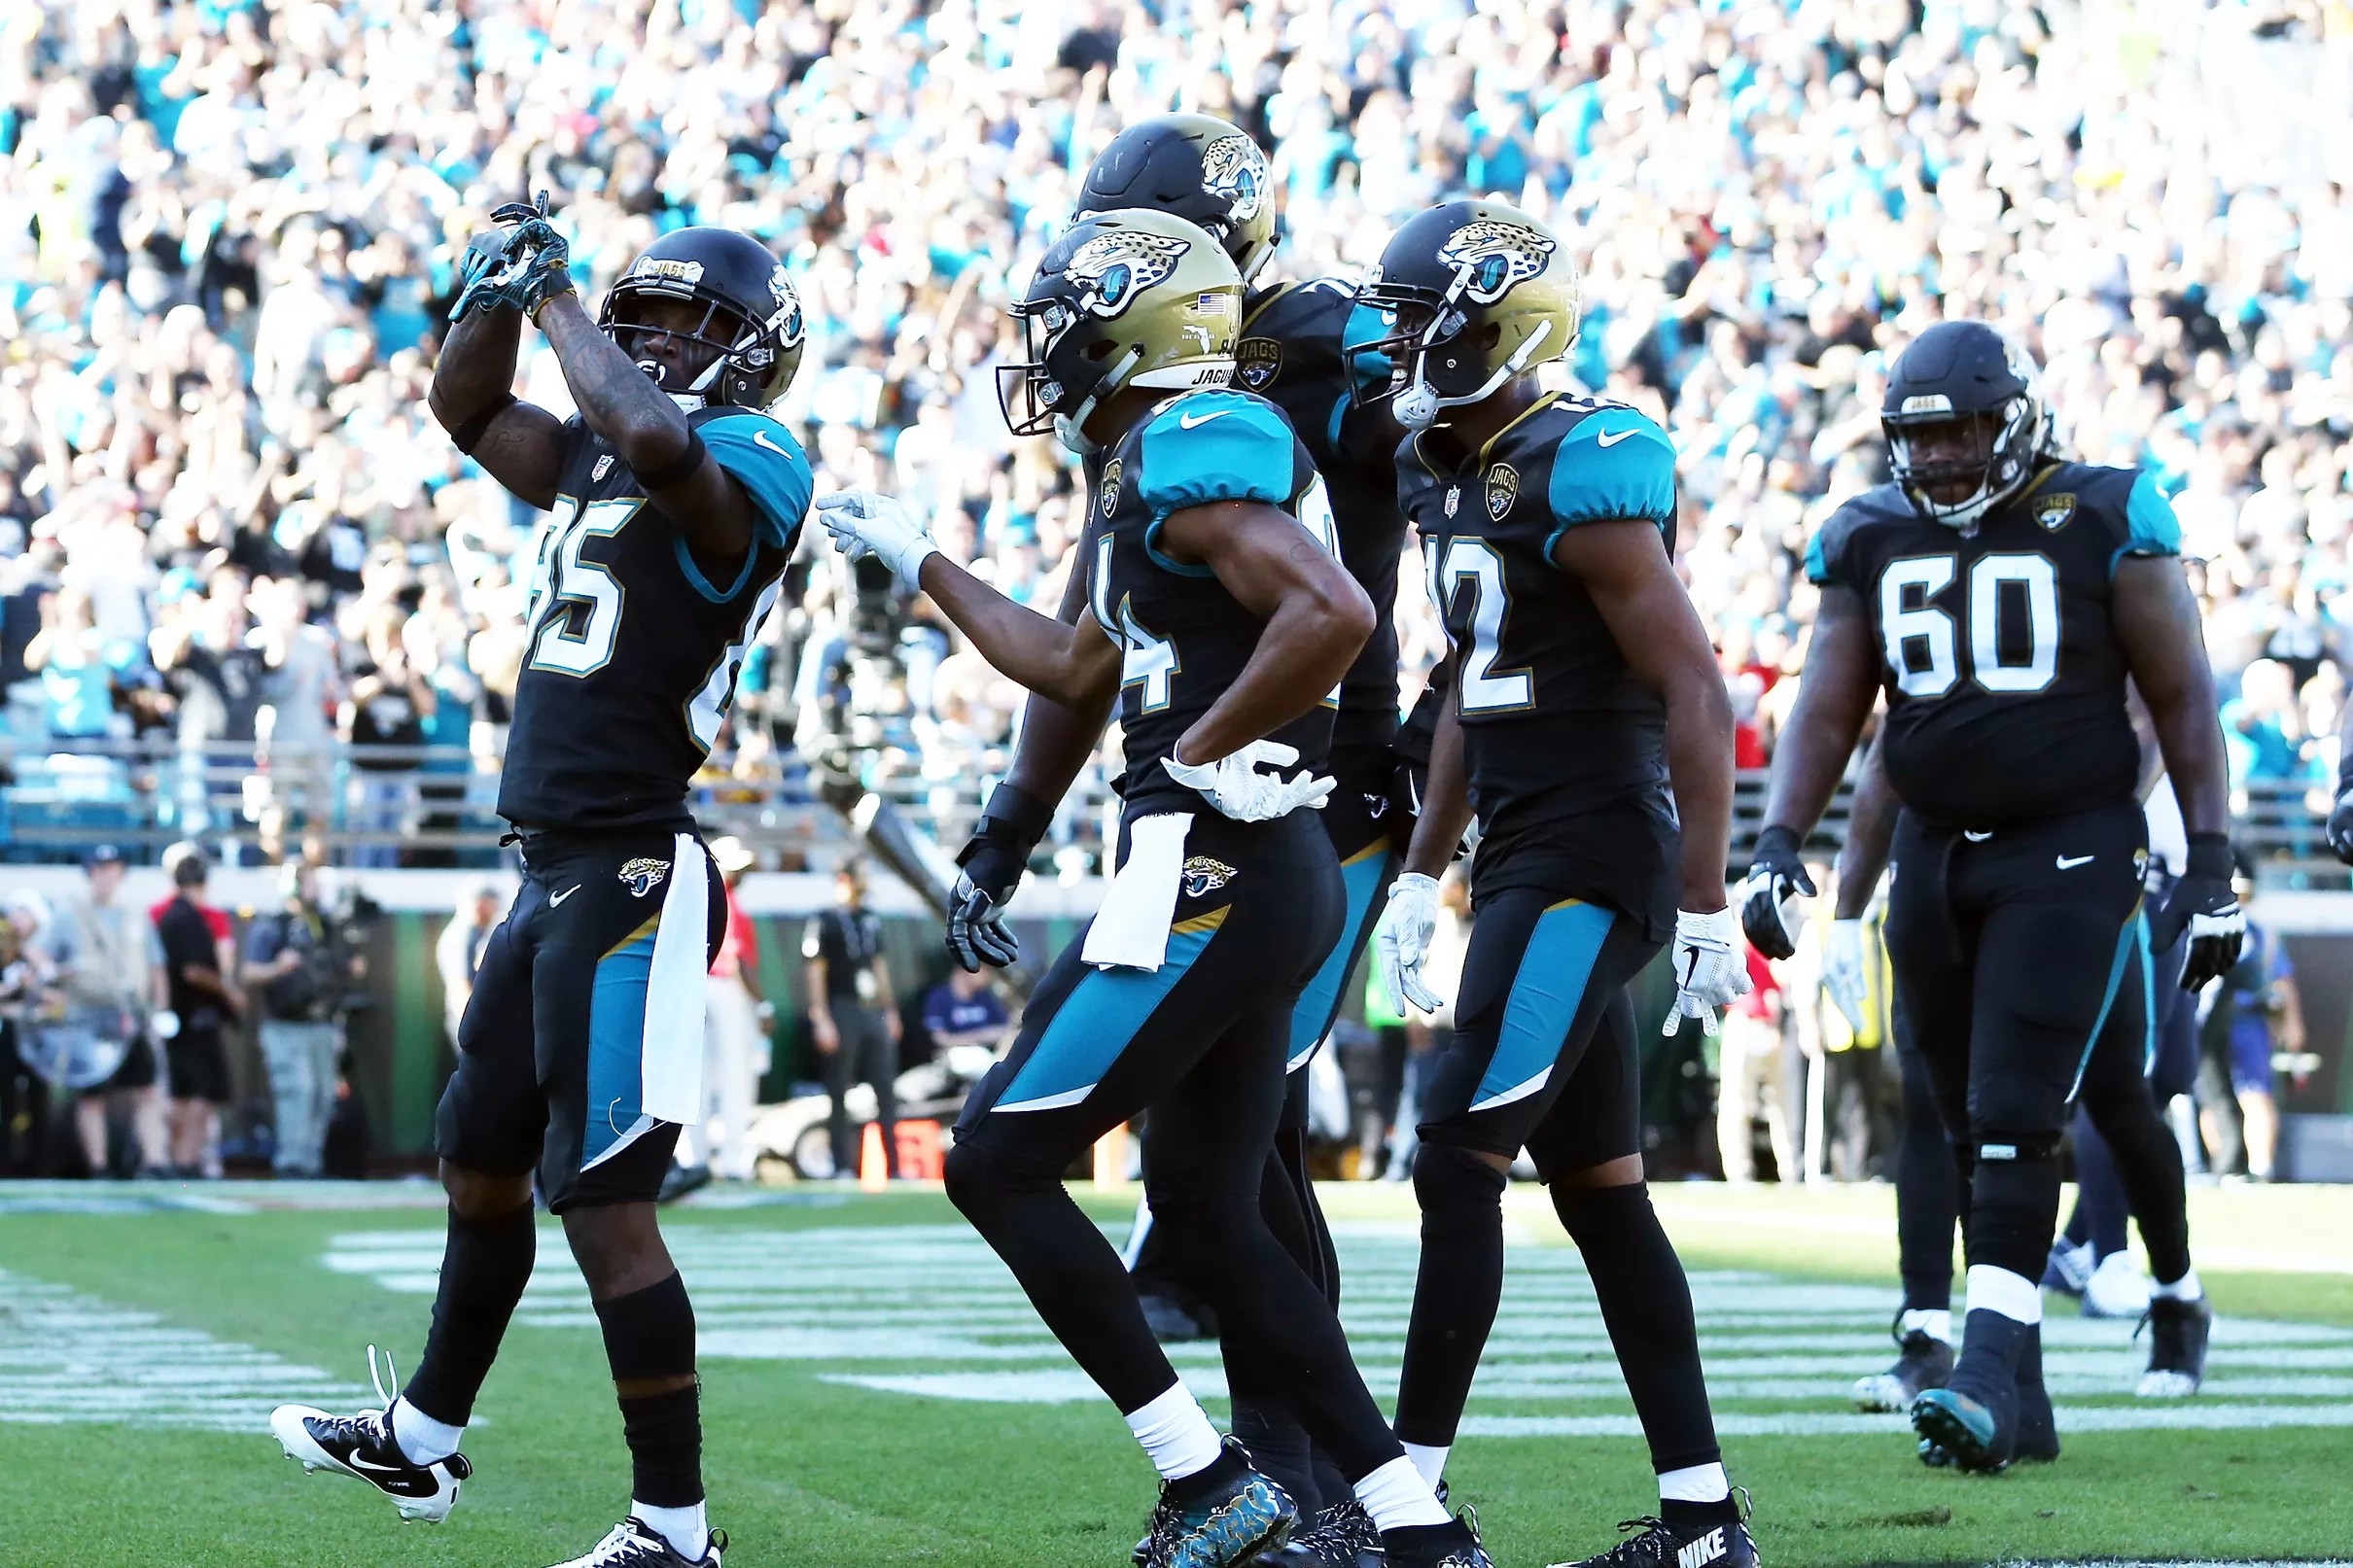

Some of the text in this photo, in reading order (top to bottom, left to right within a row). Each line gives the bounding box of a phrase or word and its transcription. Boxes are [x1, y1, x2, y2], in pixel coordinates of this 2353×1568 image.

[1238, 341, 1280, 360] JAGS
[1490, 468, 1517, 492] JAGS
[1879, 550, 2064, 700] 60
[1677, 1526, 1727, 1568] NIKE
